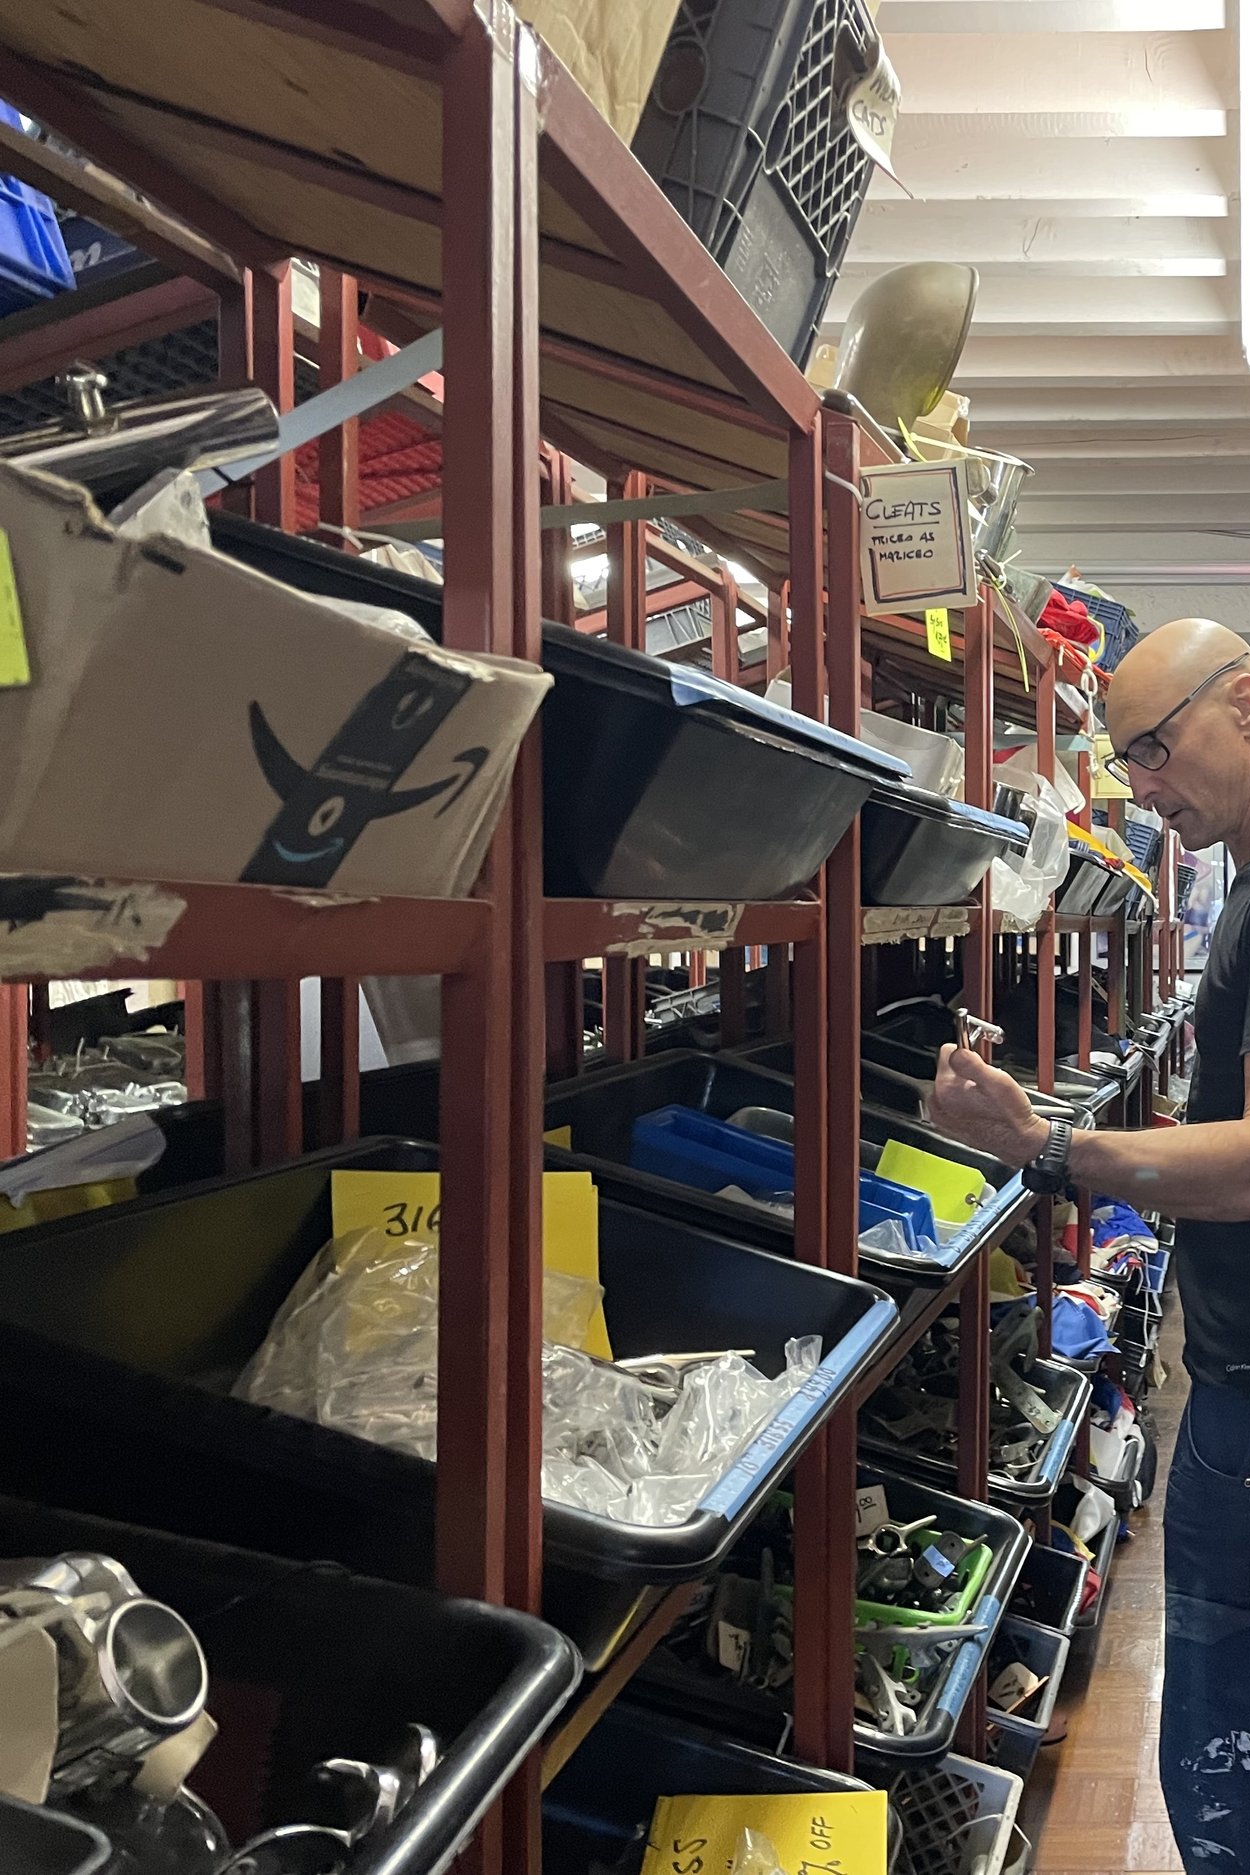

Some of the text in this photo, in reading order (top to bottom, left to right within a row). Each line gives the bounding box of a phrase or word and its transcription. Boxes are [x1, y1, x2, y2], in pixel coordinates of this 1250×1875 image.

[866, 499, 942, 522] CLEATS
[919, 531, 935, 543] AS
[810, 1816, 834, 1850] OFF
